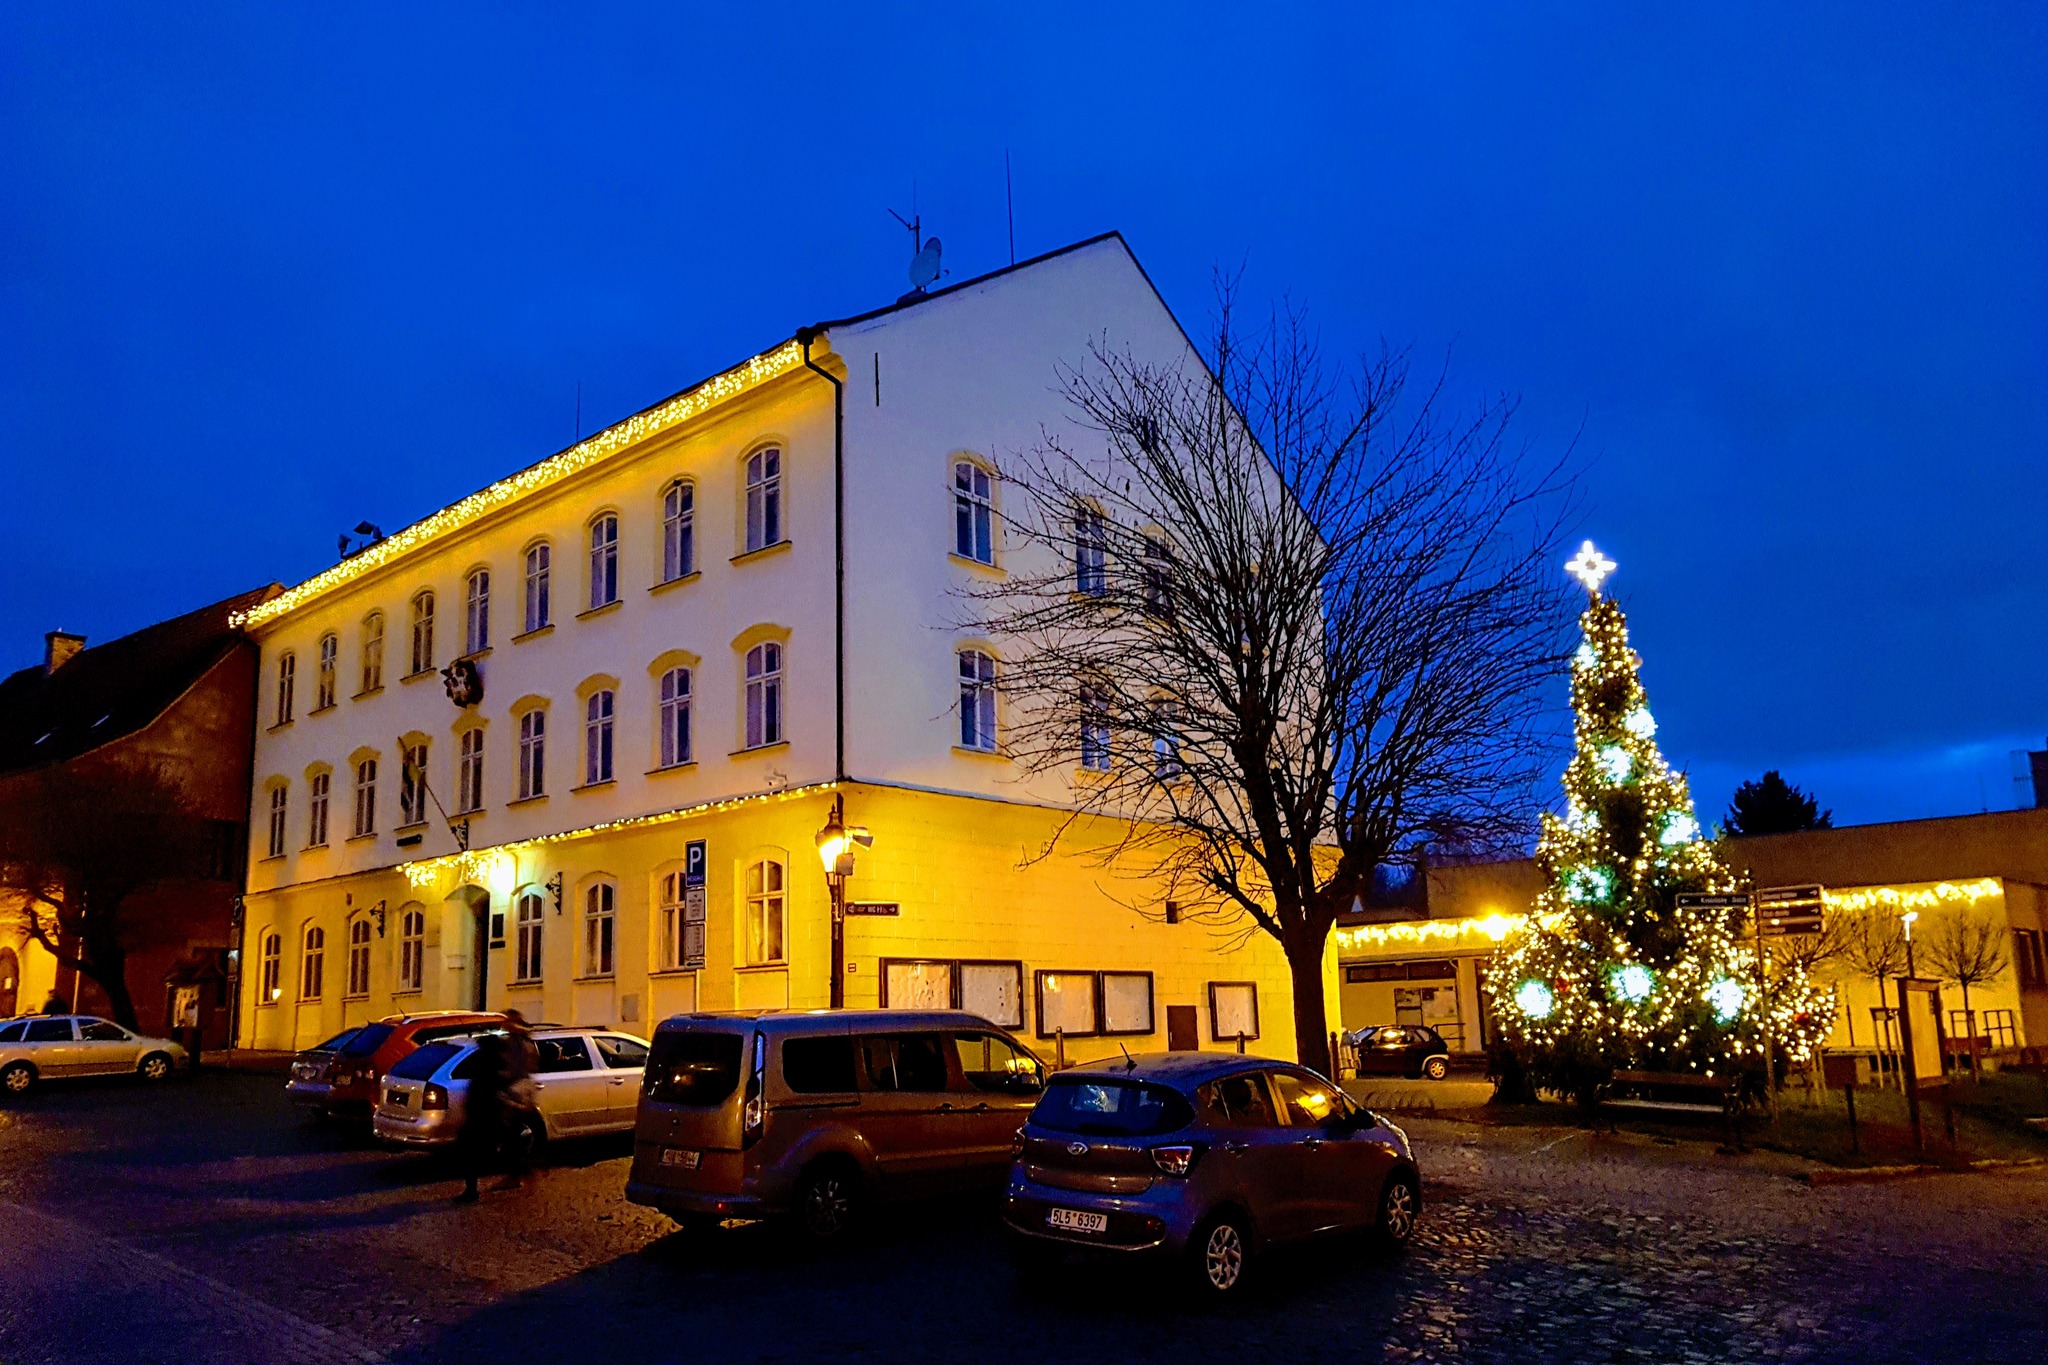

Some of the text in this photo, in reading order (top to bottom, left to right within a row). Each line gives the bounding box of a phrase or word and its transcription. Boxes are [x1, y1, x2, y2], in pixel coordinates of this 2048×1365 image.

[689, 846, 702, 873] P
[1053, 1209, 1102, 1229] 5L5 6397
